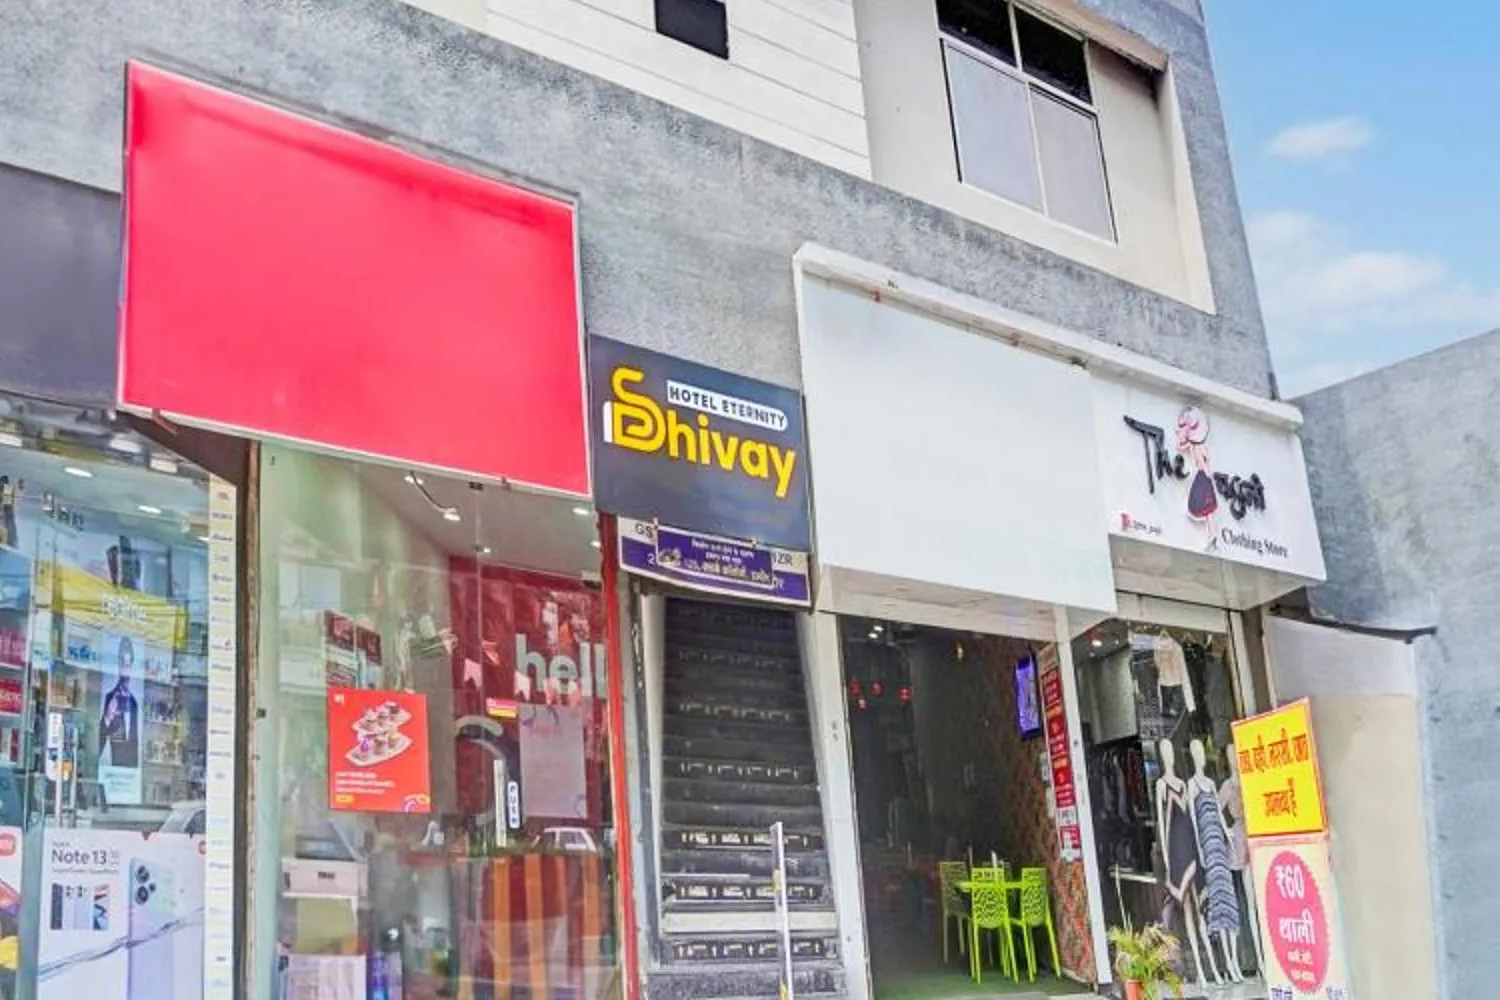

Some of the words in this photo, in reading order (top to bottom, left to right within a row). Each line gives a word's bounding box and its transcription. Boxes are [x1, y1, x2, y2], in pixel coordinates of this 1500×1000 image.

[611, 367, 797, 498] Shivay
[669, 386, 717, 411] HOTEL
[722, 400, 785, 427] ETERNITY
[1123, 415, 1190, 494] The
[52, 849, 90, 865] Note
[92, 849, 107, 865] 13
